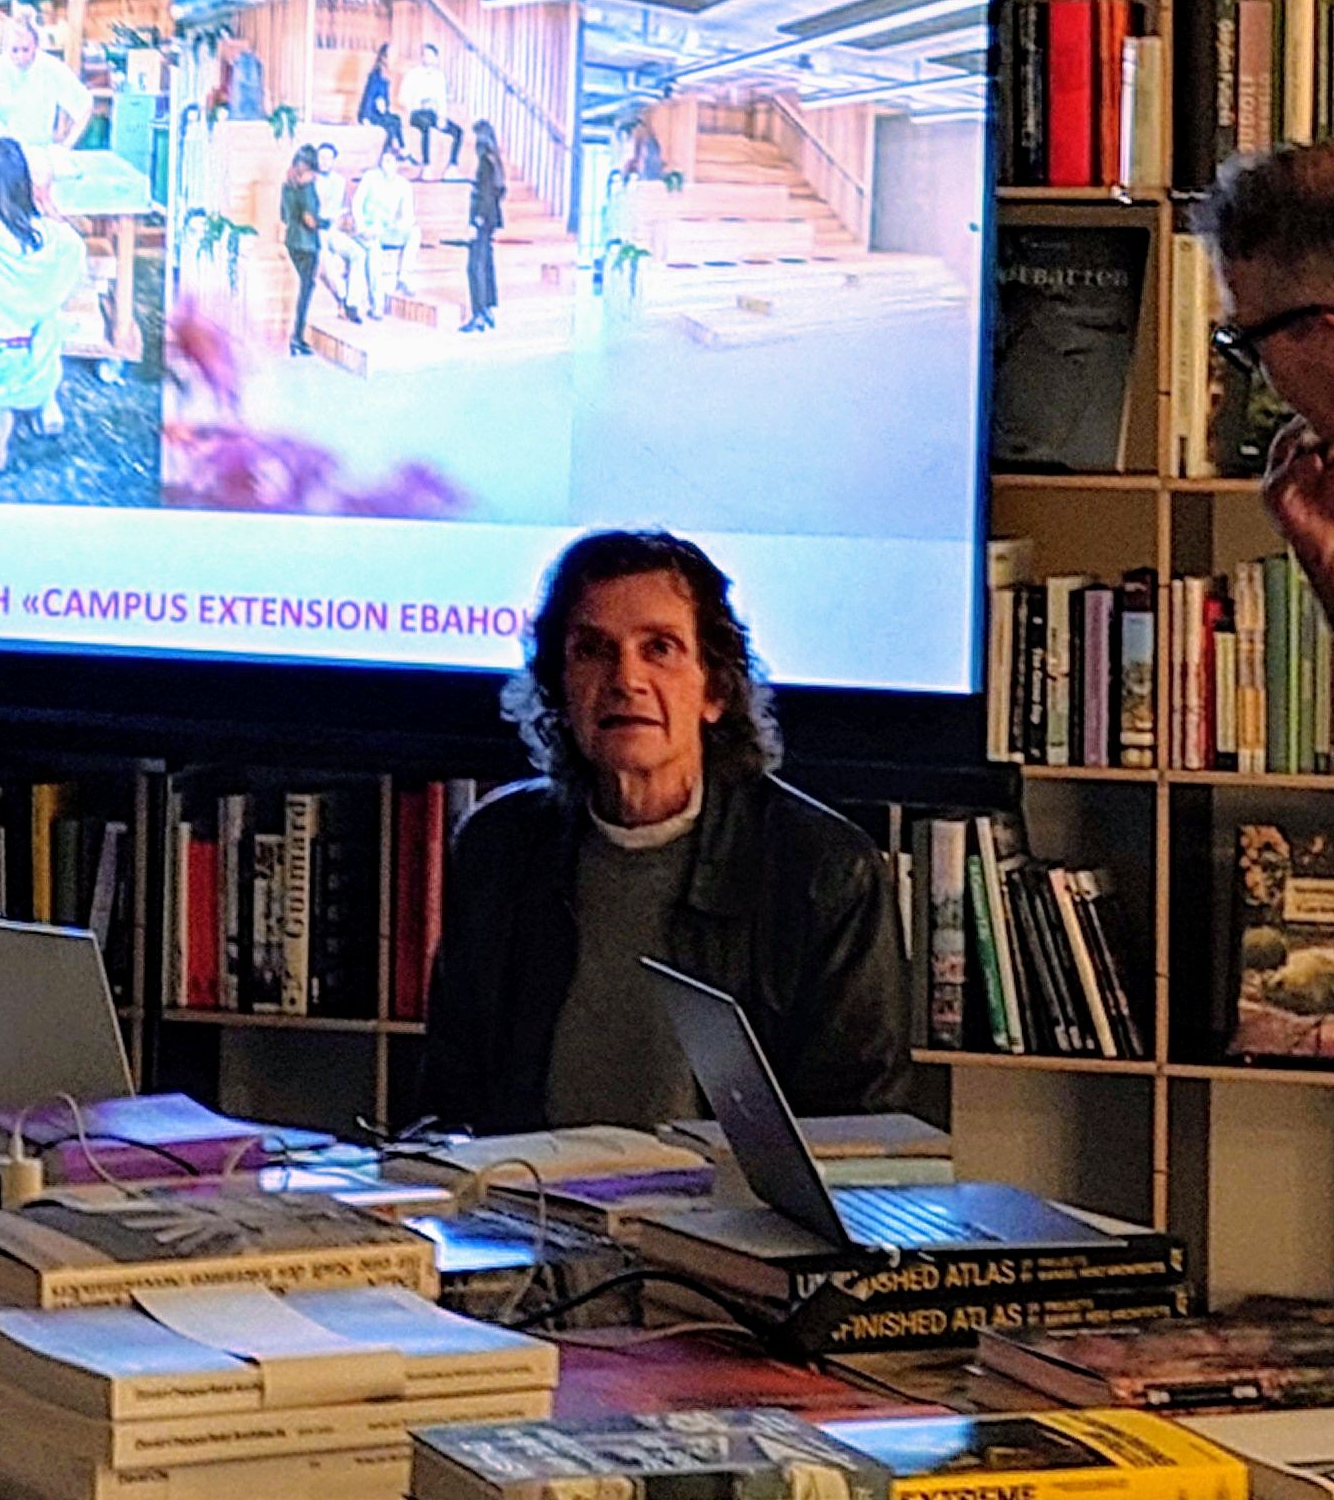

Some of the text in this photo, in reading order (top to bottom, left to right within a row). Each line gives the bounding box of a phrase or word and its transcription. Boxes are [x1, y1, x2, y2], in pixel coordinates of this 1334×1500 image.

[21, 587, 188, 623] «CAMPUS
[198, 594, 389, 632] EXTENSION
[399, 602, 529, 638] EBAHO
[944, 1257, 1017, 1289] ATLAS
